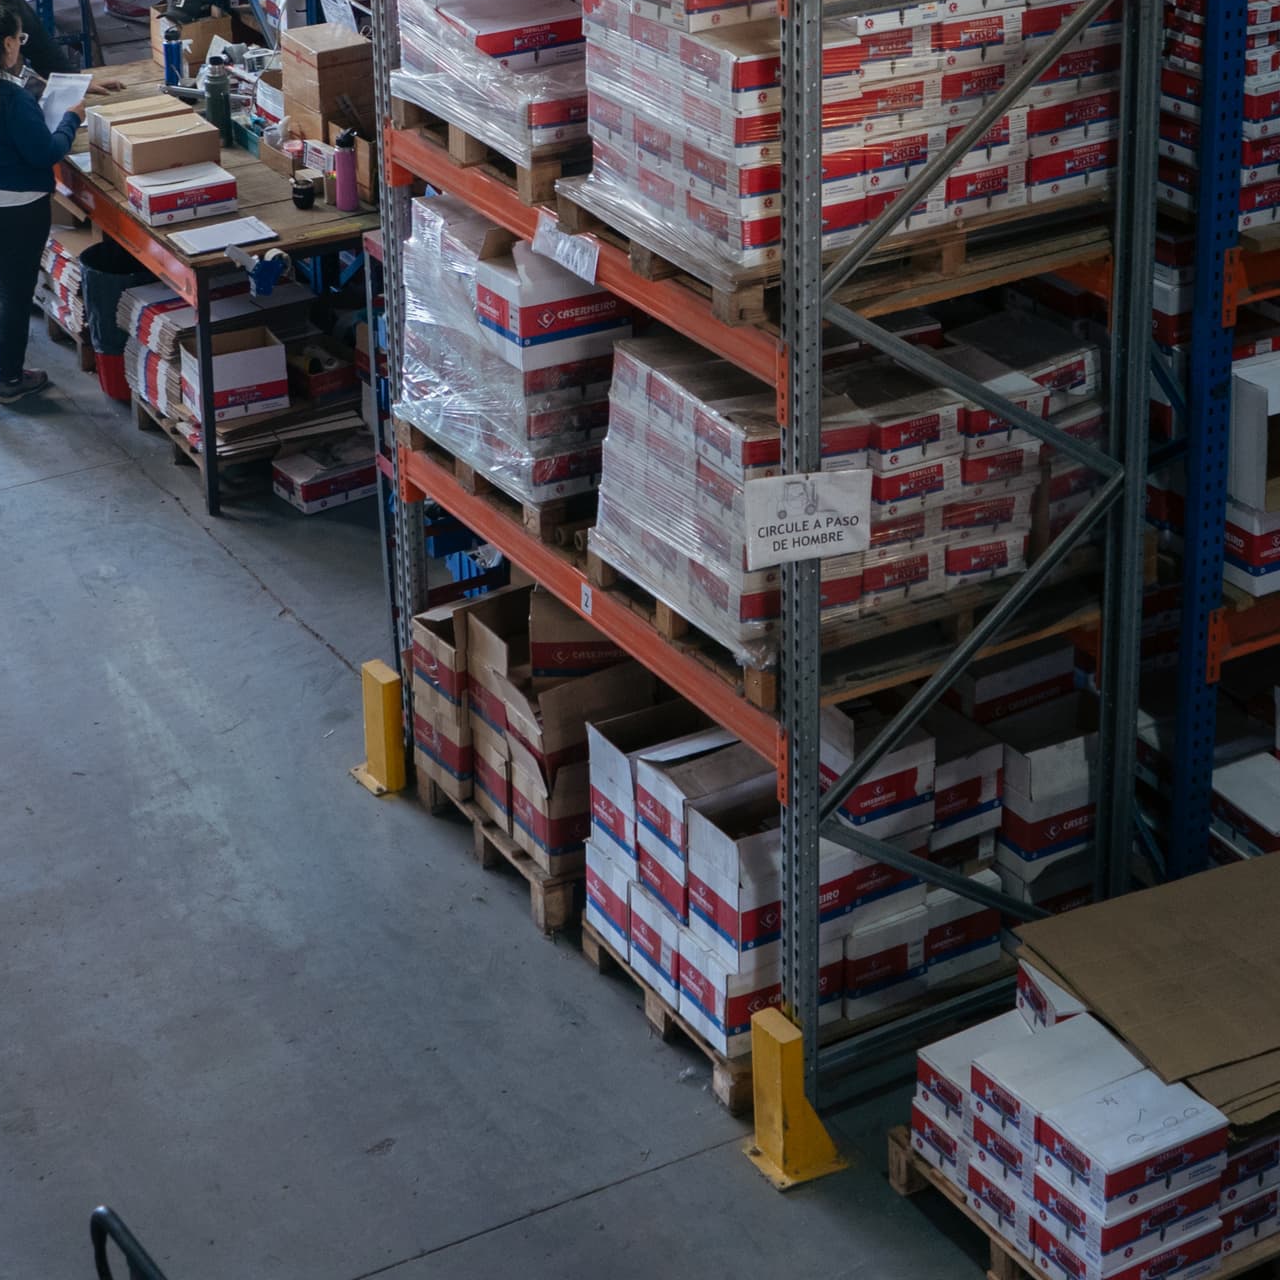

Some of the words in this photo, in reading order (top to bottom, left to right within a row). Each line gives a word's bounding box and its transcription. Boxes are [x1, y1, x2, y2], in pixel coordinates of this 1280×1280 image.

[523, 24, 550, 34] TORNILLOS
[969, 17, 1002, 28] TORNILLOS
[968, 27, 999, 43] CASER
[891, 145, 922, 163] CASER
[1071, 153, 1100, 170] CASER
[976, 167, 1004, 178] TORNILLOS
[974, 176, 1004, 193] CASER
[556, 300, 617, 320] CASERMEIRO
[757, 520, 809, 539] CIRCULE
[813, 519, 822, 529] A
[826, 515, 859, 528] PASO
[772, 539, 788, 552] DE
[792, 530, 844, 548] HOMBRE
[584, 591, 590, 609] 2
